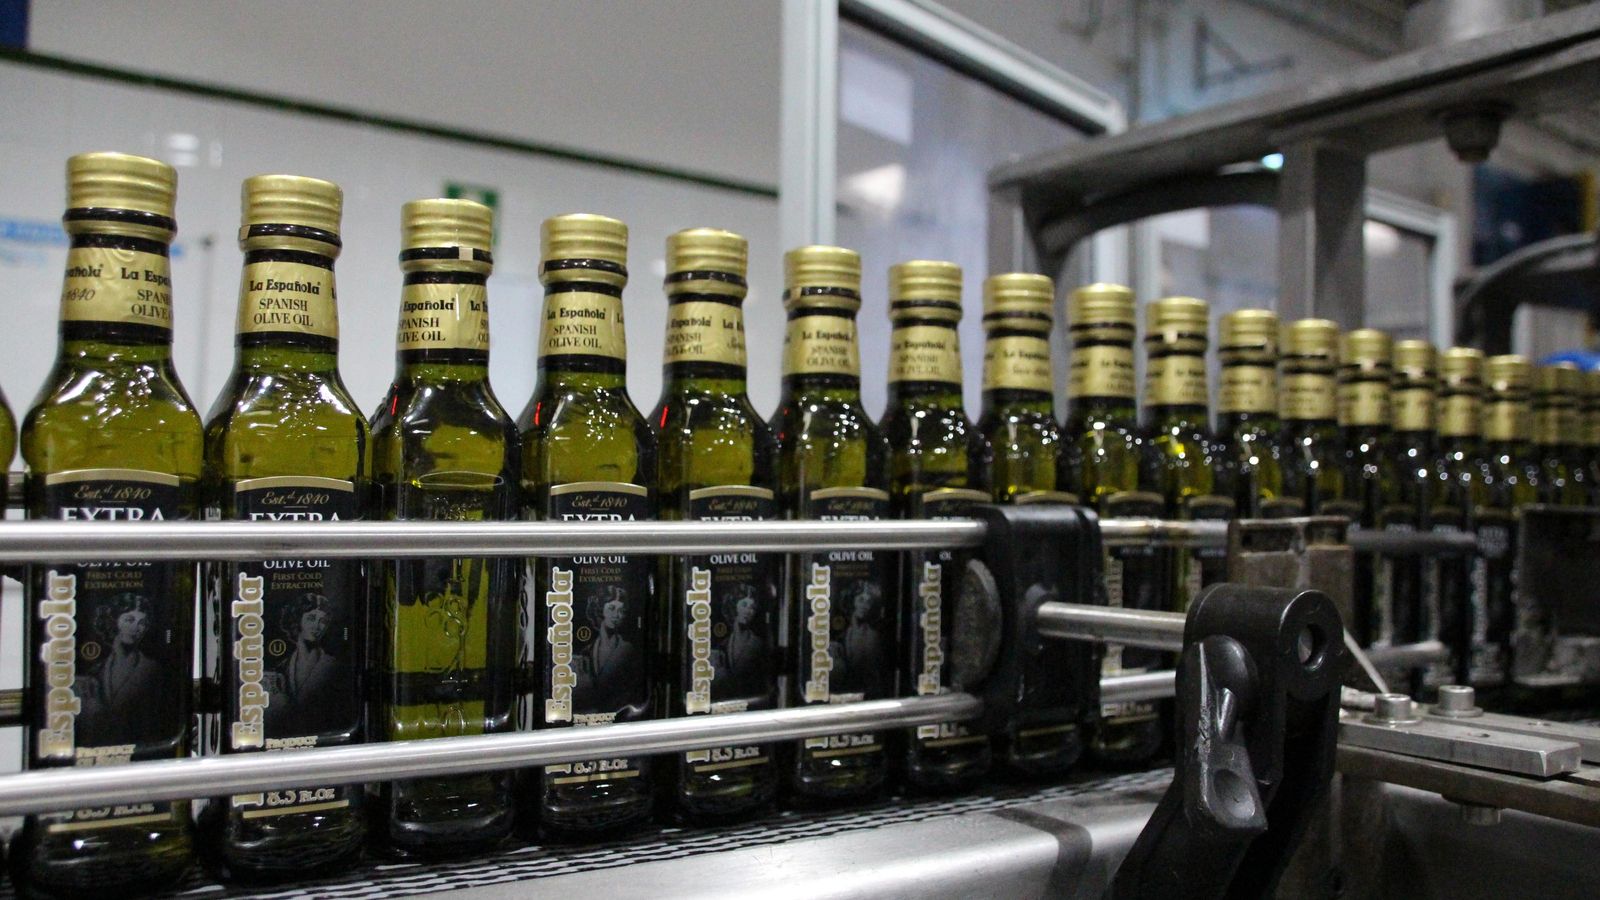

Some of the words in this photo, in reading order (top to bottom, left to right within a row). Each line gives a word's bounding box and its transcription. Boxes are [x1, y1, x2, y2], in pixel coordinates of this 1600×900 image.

[121, 267, 139, 280] La
[250, 280, 263, 291] La
[266, 279, 319, 295] Española
[259, 298, 308, 312] SPANISH
[253, 312, 290, 325] OLIVE
[293, 314, 314, 327] OIL
[560, 307, 606, 320] Española
[421, 330, 446, 342] OIL
[554, 325, 597, 336] SPANISH
[549, 337, 580, 348] OLIVE
[583, 337, 602, 349] OIL
[296, 492, 330, 505] 1840
[273, 572, 296, 581] FIRST
[298, 572, 322, 580] COLD
[271, 581, 324, 590] EXTRACTION
[545, 566, 576, 724] Española
[232, 572, 269, 748] Española
